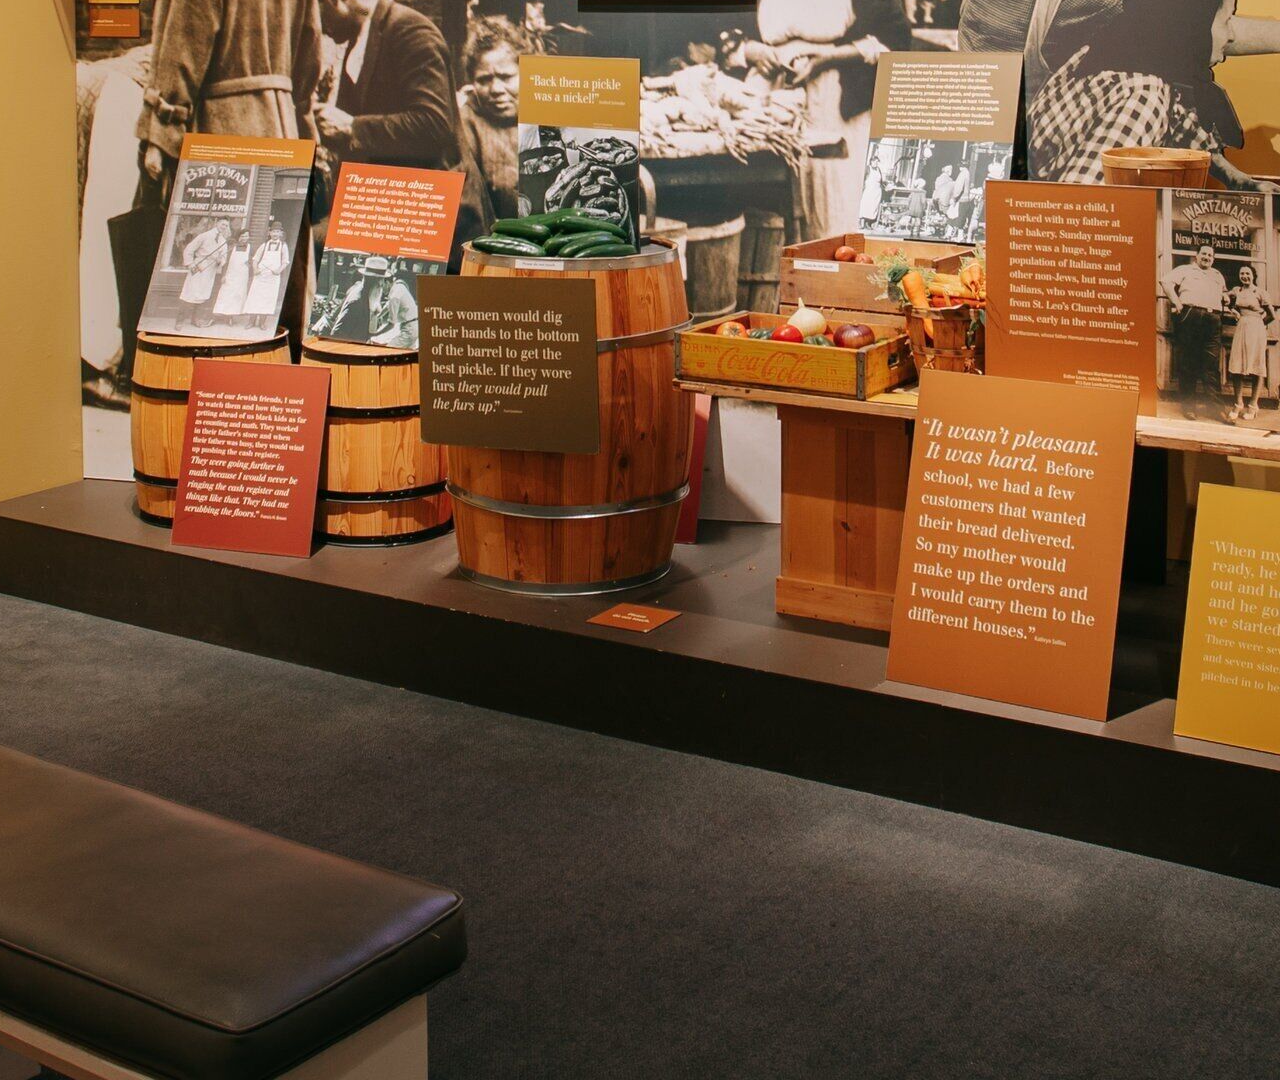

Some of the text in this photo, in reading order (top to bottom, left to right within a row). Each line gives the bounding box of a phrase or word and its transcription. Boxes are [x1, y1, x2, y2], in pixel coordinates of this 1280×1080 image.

[559, 76, 581, 88] then
[583, 80, 589, 89] a
[591, 78, 621, 92] pickle
[534, 92, 553, 102] was
[554, 94, 561, 102] a
[1015, 200, 1062, 210] remember
[1075, 203, 1082, 211] a
[1111, 203, 1115, 213] I
[1192, 220, 1248, 238] BAKERY
[456, 310, 499, 321] women
[503, 309, 540, 323] would
[543, 310, 563, 326] dig
[431, 325, 579, 342] their hands to the bottom
[717, 346, 814, 384] Coca-Cola
[433, 397, 450, 410] the
[450, 399, 475, 412] furs
[948, 426, 1009, 447] wasn’t
[1012, 430, 1099, 457] pleasant.
[925, 441, 1094, 480] It was hard. Before
